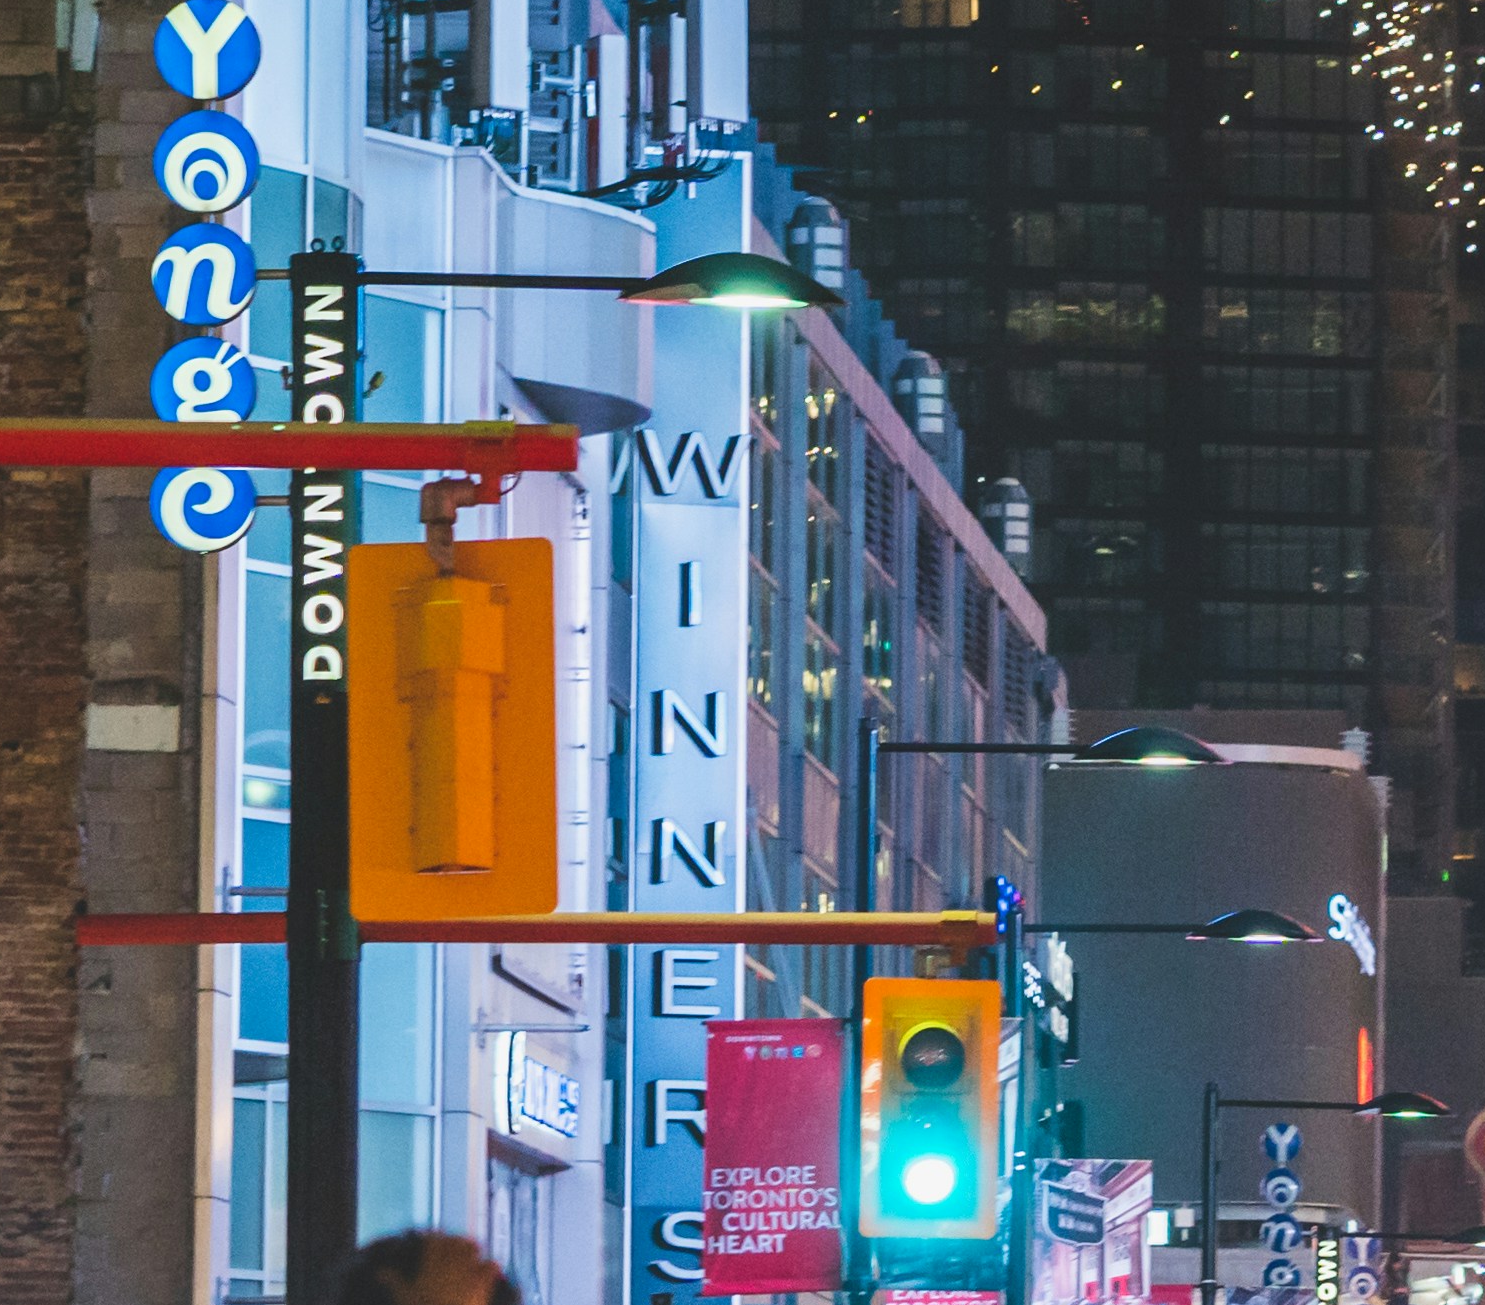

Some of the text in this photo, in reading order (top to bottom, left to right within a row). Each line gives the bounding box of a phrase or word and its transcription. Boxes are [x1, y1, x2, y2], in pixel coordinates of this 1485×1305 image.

[303, 286, 343, 680] DOWNOWN
[637, 430, 752, 1283] WINNERS
[711, 1165, 817, 1187] EXPLORE
[702, 1187, 838, 1210] TORONTO'S
[721, 1211, 841, 1232] CULTURAL
[706, 1233, 788, 1255] HEART
